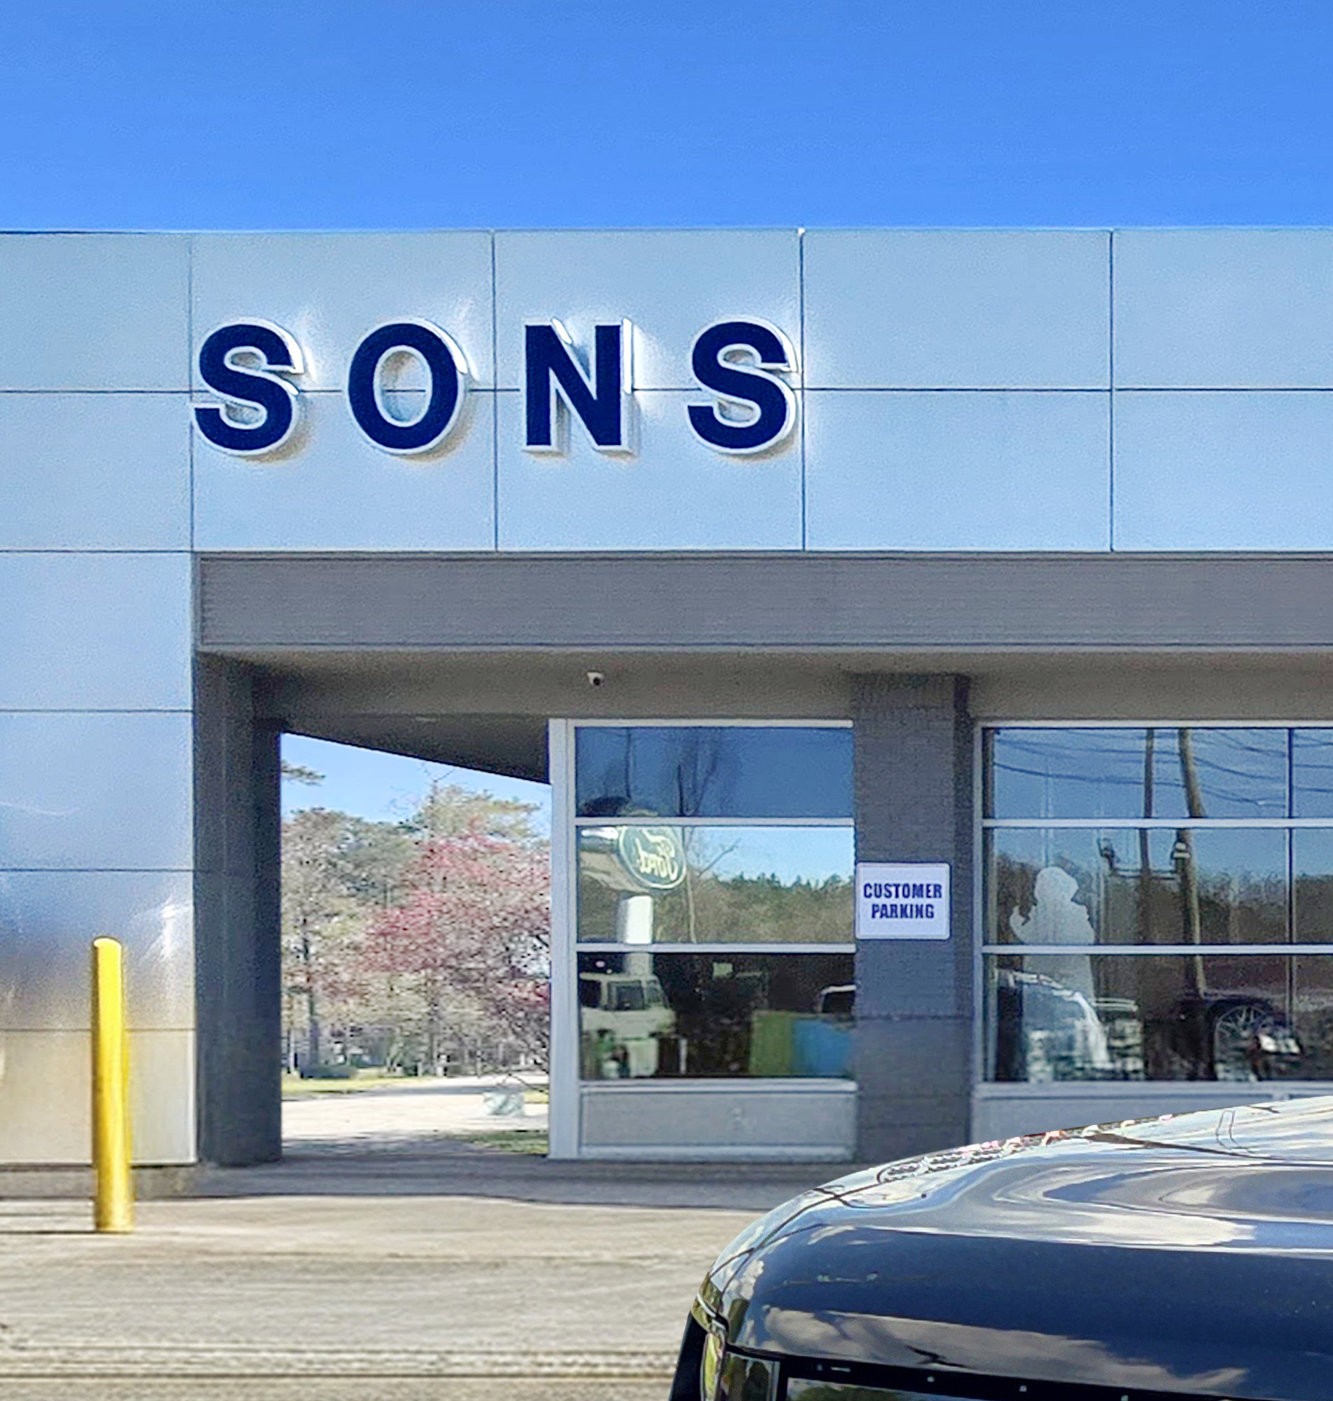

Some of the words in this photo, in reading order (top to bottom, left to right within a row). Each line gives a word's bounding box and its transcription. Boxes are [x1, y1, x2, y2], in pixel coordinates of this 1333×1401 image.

[193, 319, 797, 454] SONS
[863, 882, 942, 899] CUSTOMER
[871, 903, 935, 919] PARKING
